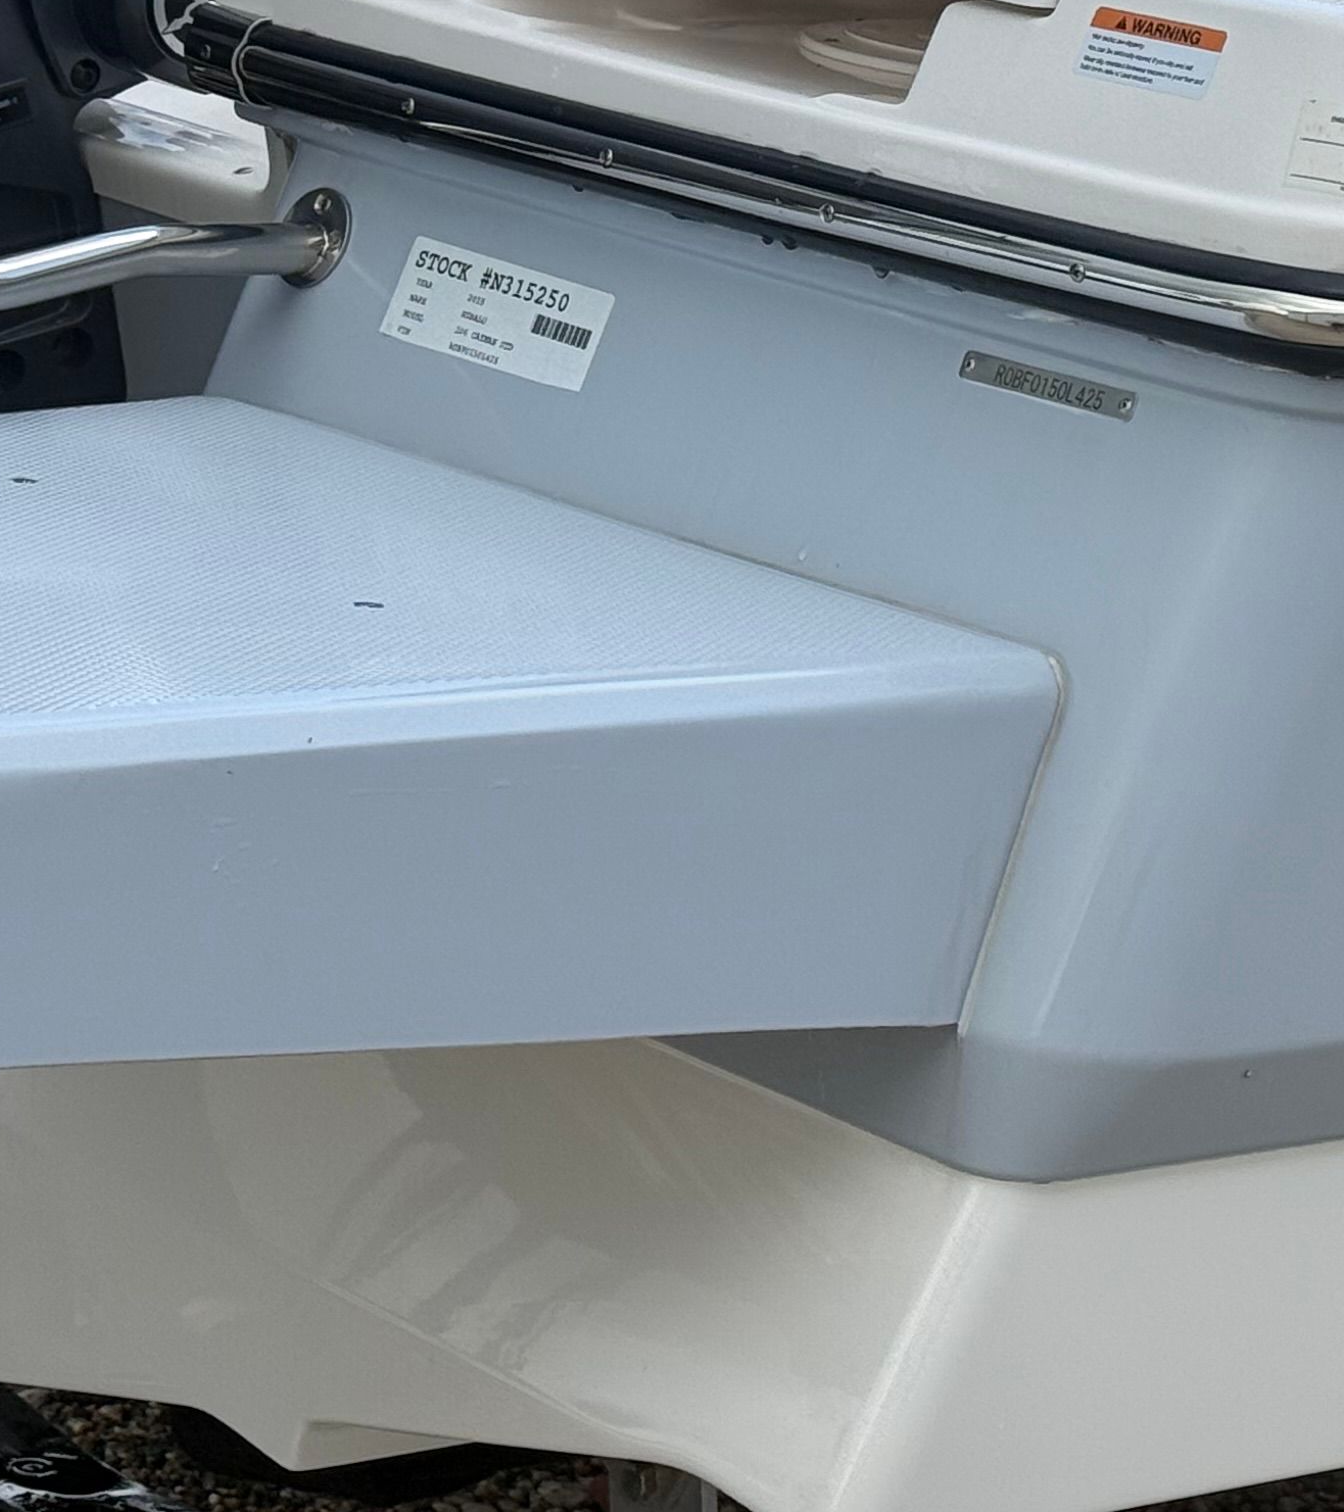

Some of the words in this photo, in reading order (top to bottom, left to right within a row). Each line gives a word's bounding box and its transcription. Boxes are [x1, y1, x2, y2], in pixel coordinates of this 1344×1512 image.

[1132, 17, 1202, 46] WARNING
[415, 250, 473, 282] STOCK
[479, 266, 570, 313] #N315250
